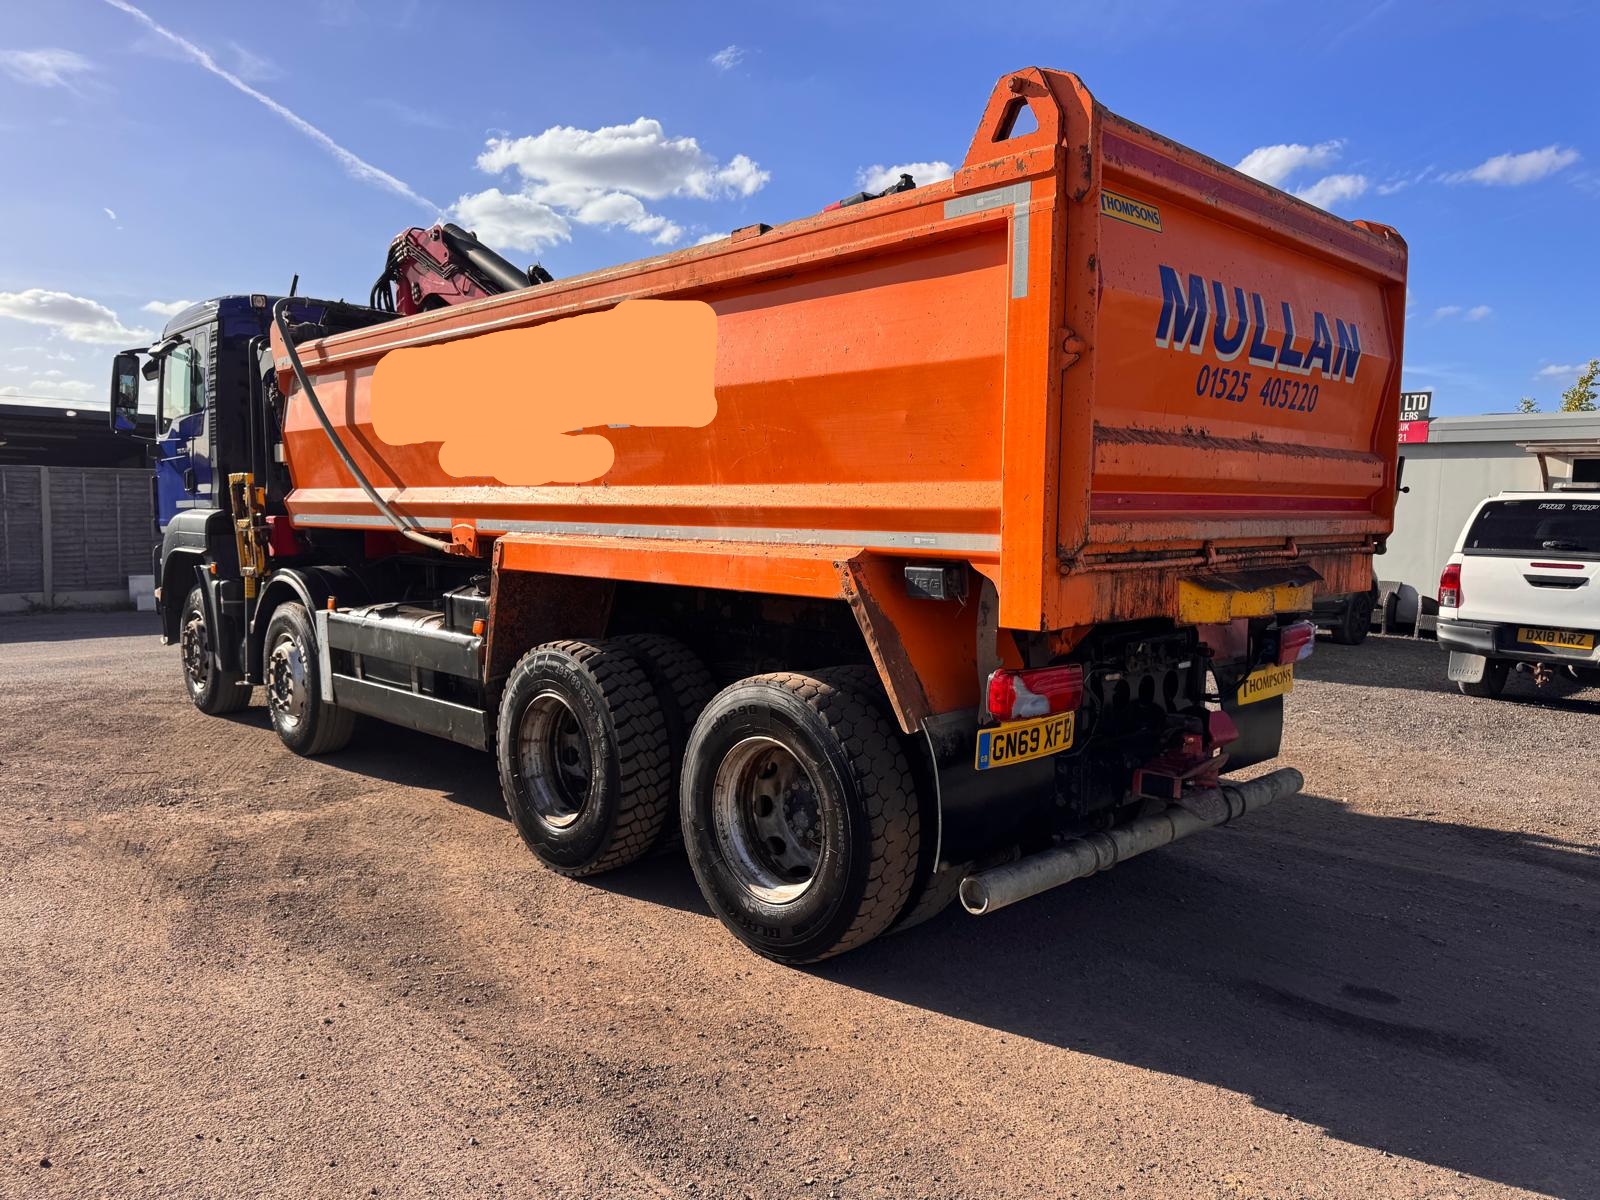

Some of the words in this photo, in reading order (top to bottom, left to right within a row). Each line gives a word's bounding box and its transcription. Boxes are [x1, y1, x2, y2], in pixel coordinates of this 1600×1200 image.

[1101, 191, 1160, 225] THOMPSONS
[1155, 264, 1361, 384] MULLAN
[1196, 365, 1251, 402] 01525
[1259, 376, 1319, 412] 405220
[1404, 394, 1428, 411] LTD
[1525, 629, 1556, 643] DX18
[1558, 632, 1586, 646] NRZ
[1243, 668, 1291, 698] THOMPSONS
[992, 727, 1040, 761] GN69
